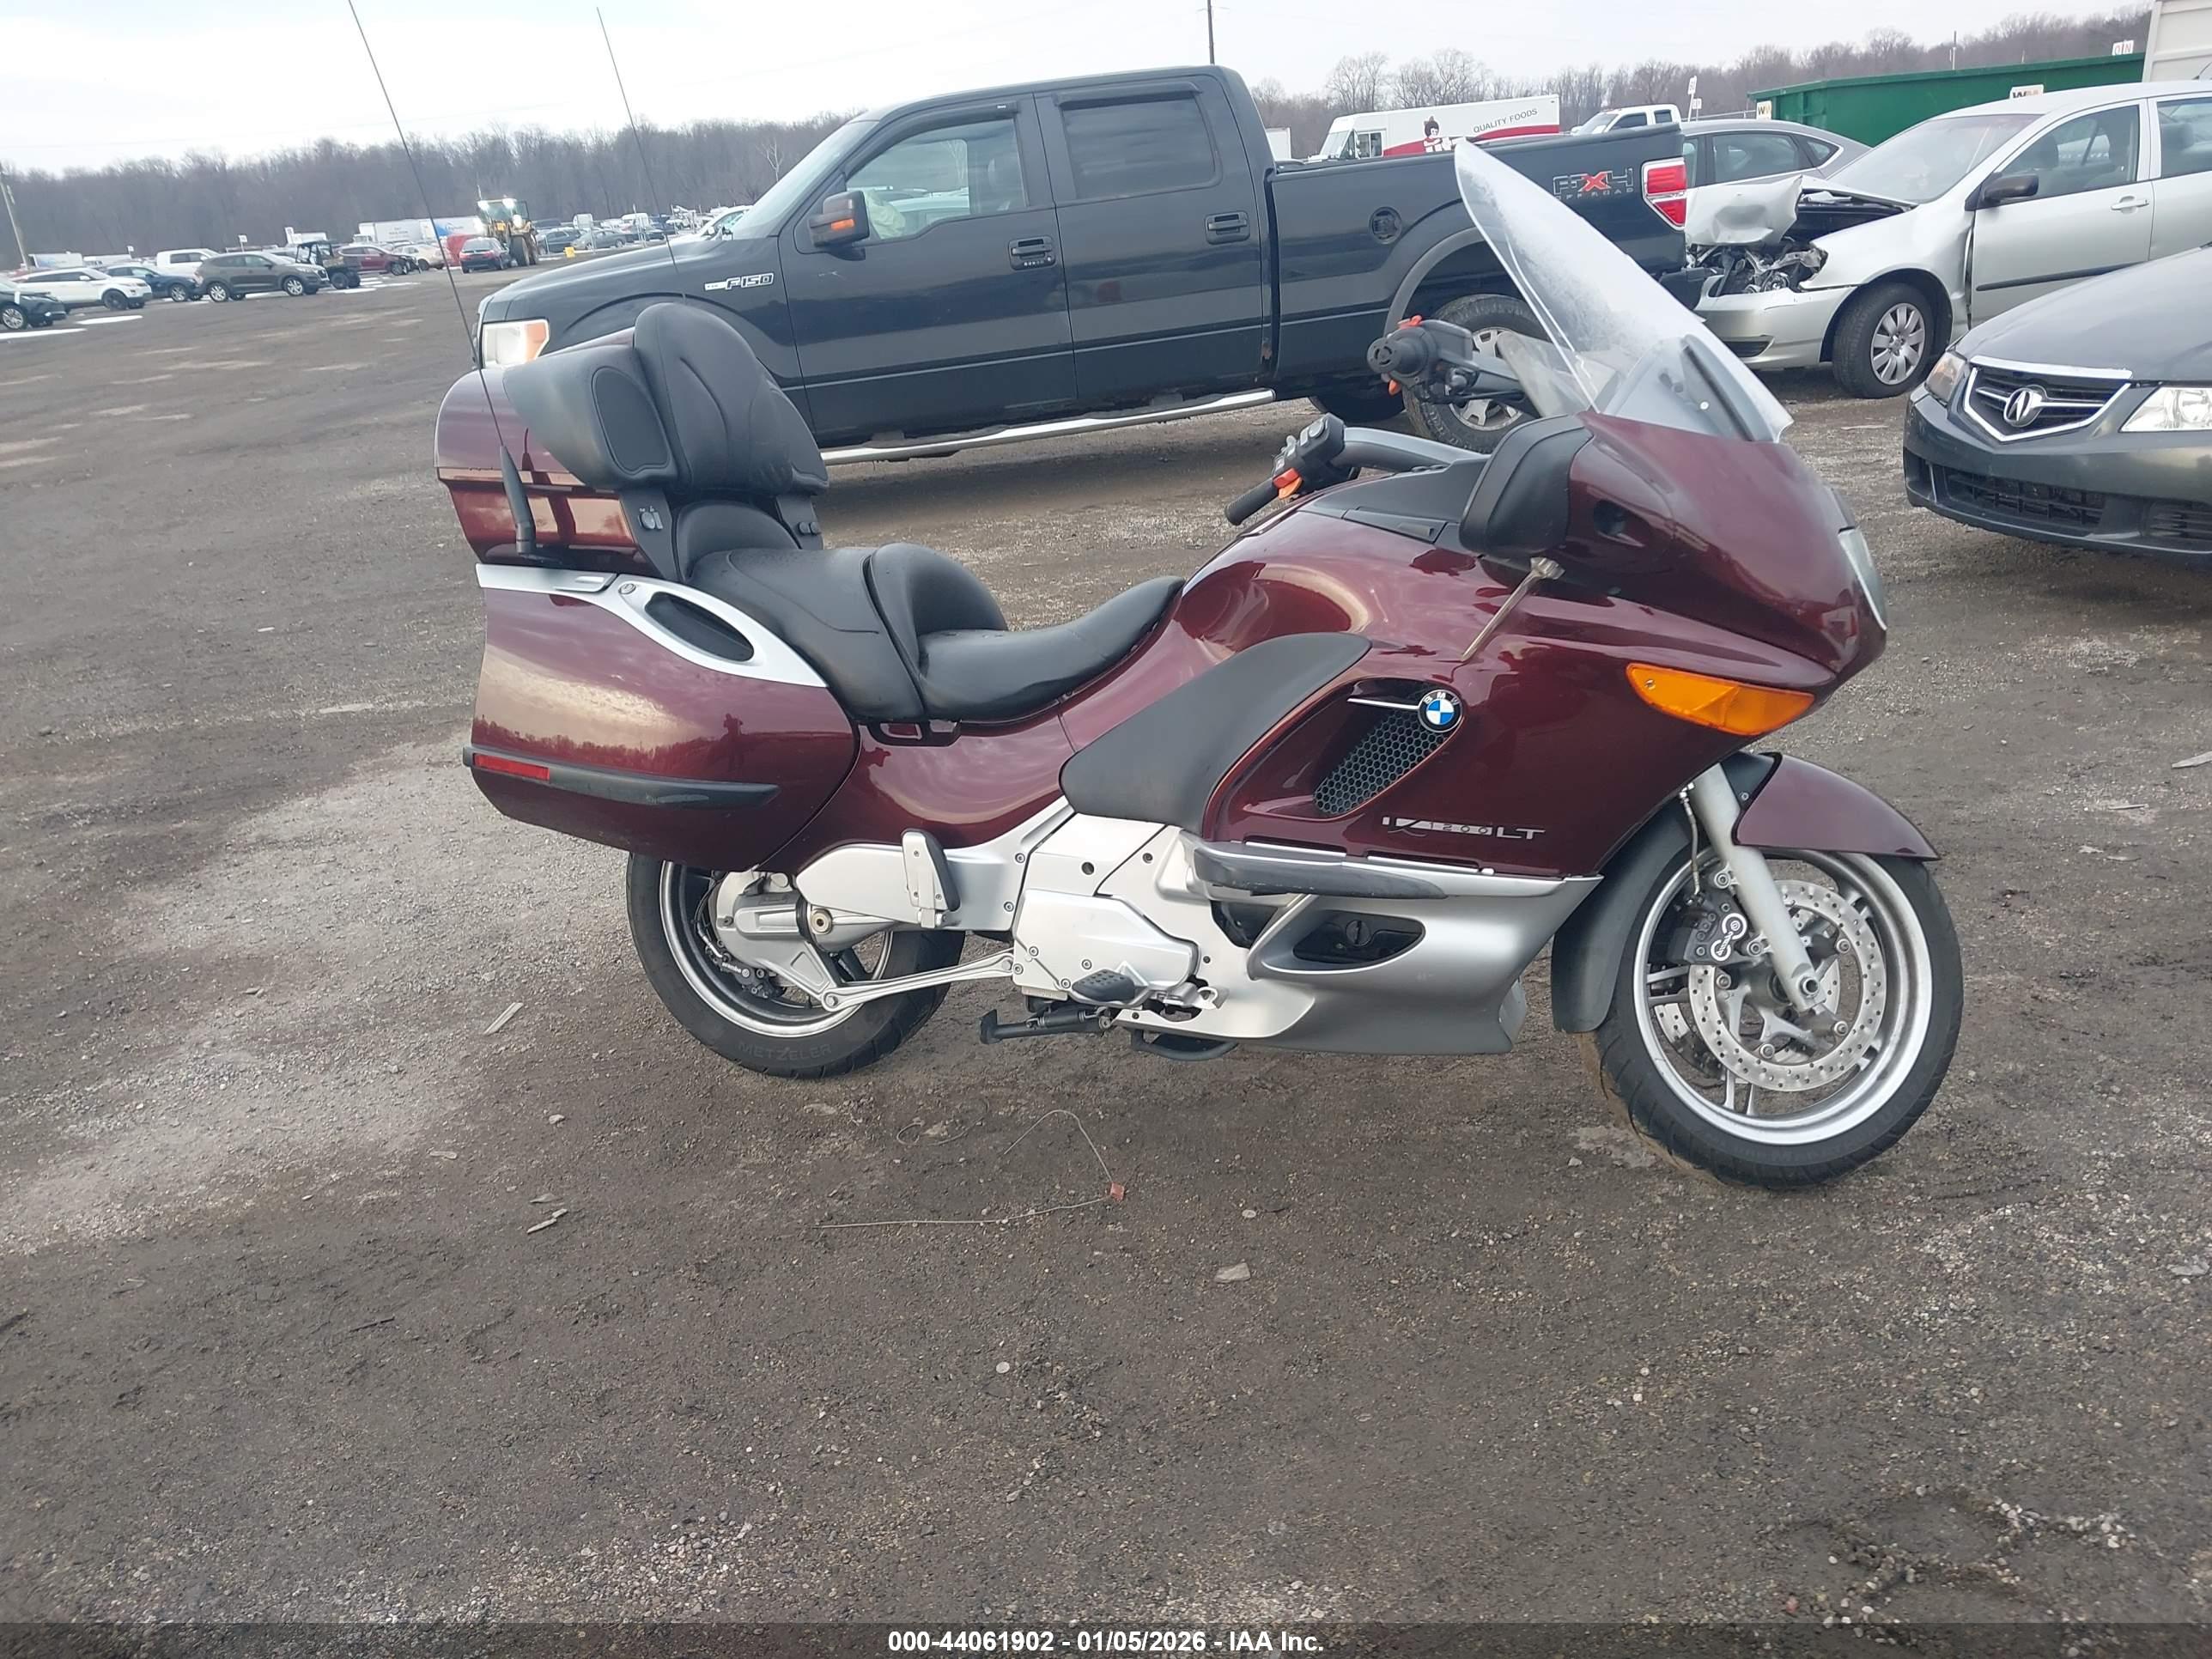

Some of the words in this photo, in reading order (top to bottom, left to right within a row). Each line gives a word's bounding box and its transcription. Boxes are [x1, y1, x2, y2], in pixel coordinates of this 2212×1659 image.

[1474, 117, 1507, 133] QUALITY
[1510, 108, 1538, 123] FOODS
[1553, 167, 1634, 196] FX4
[1422, 691, 1461, 706] BMW
[738, 1041, 832, 1061] METZELER
